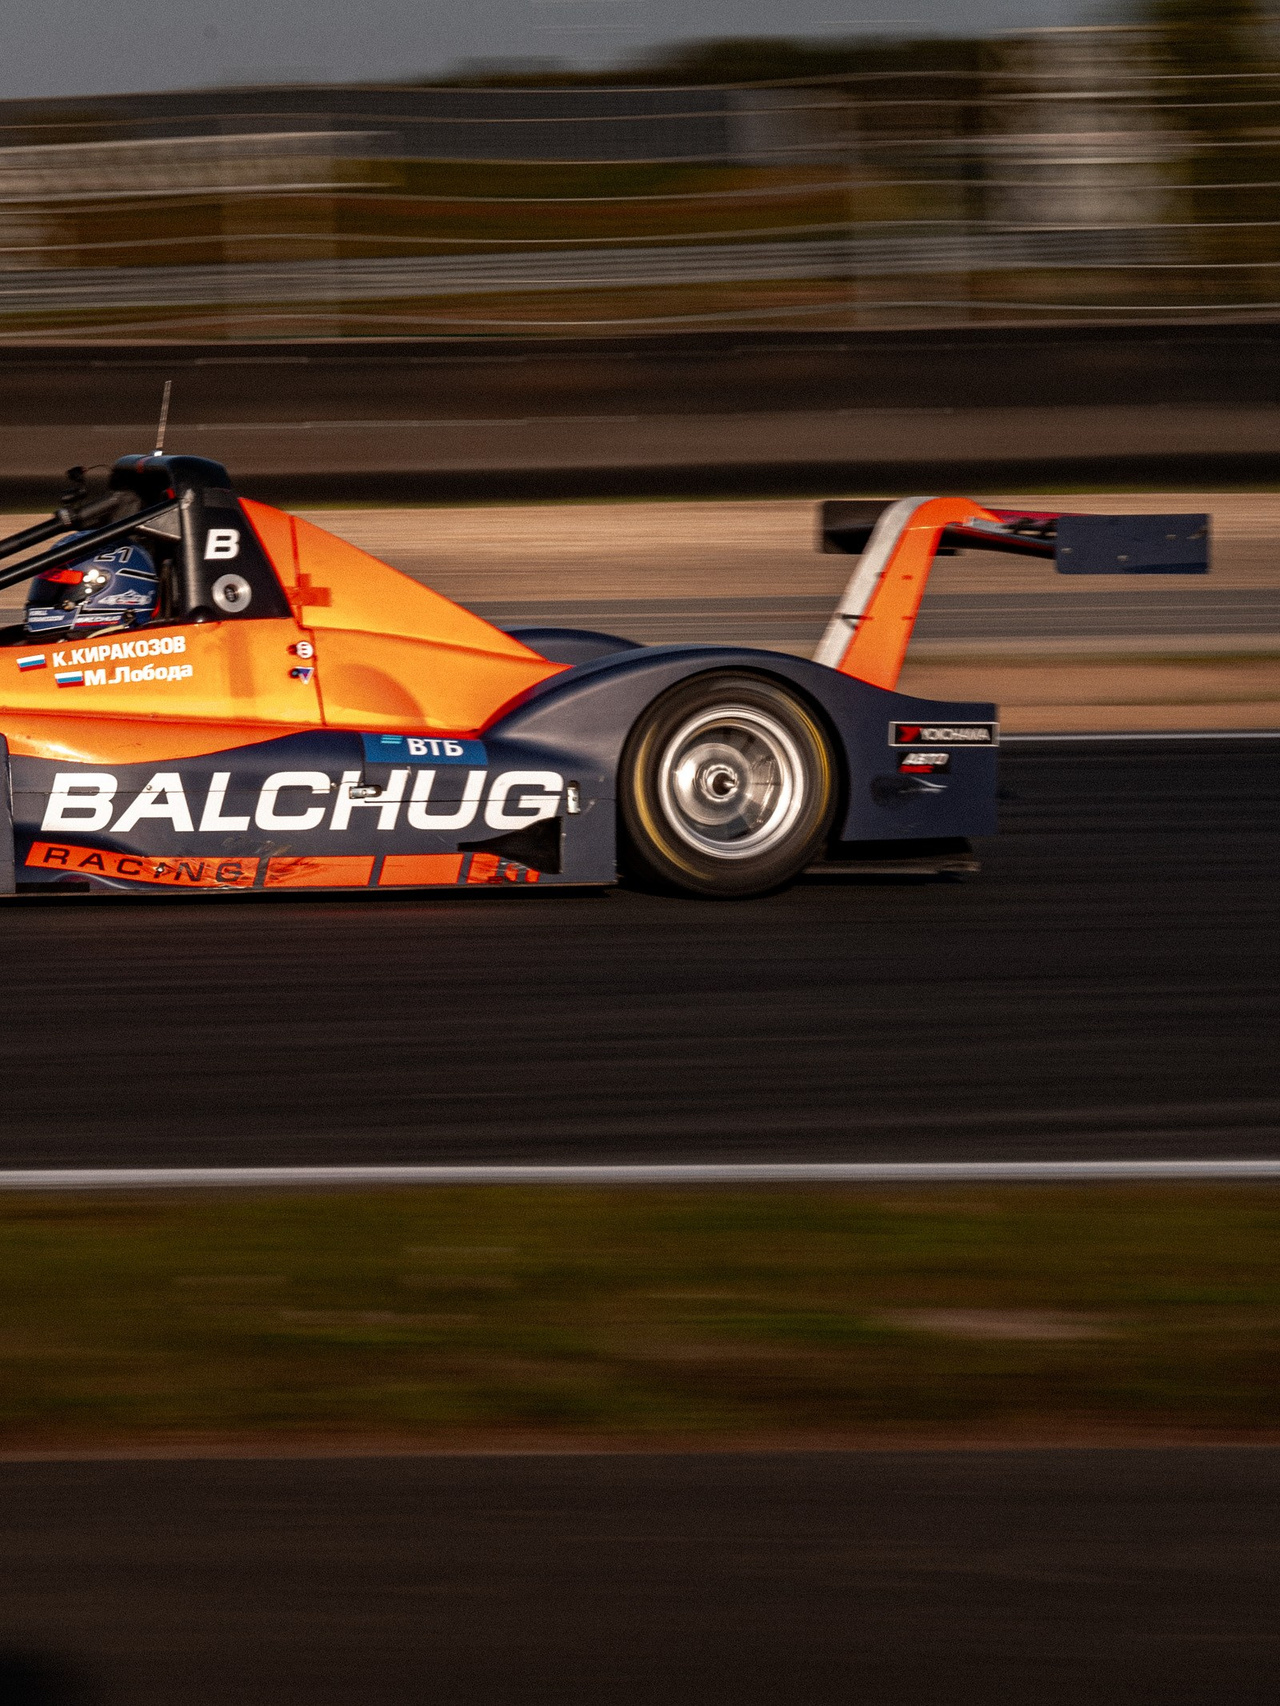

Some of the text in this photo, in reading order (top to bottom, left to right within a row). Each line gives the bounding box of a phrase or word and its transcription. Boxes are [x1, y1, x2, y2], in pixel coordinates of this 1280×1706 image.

[204, 528, 241, 560] B
[52, 635, 186, 668] К.КИРАКОЗОВ
[84, 663, 193, 686] М.Лобода
[406, 738, 465, 757] ВТБ
[40, 769, 565, 832] BALCHUG
